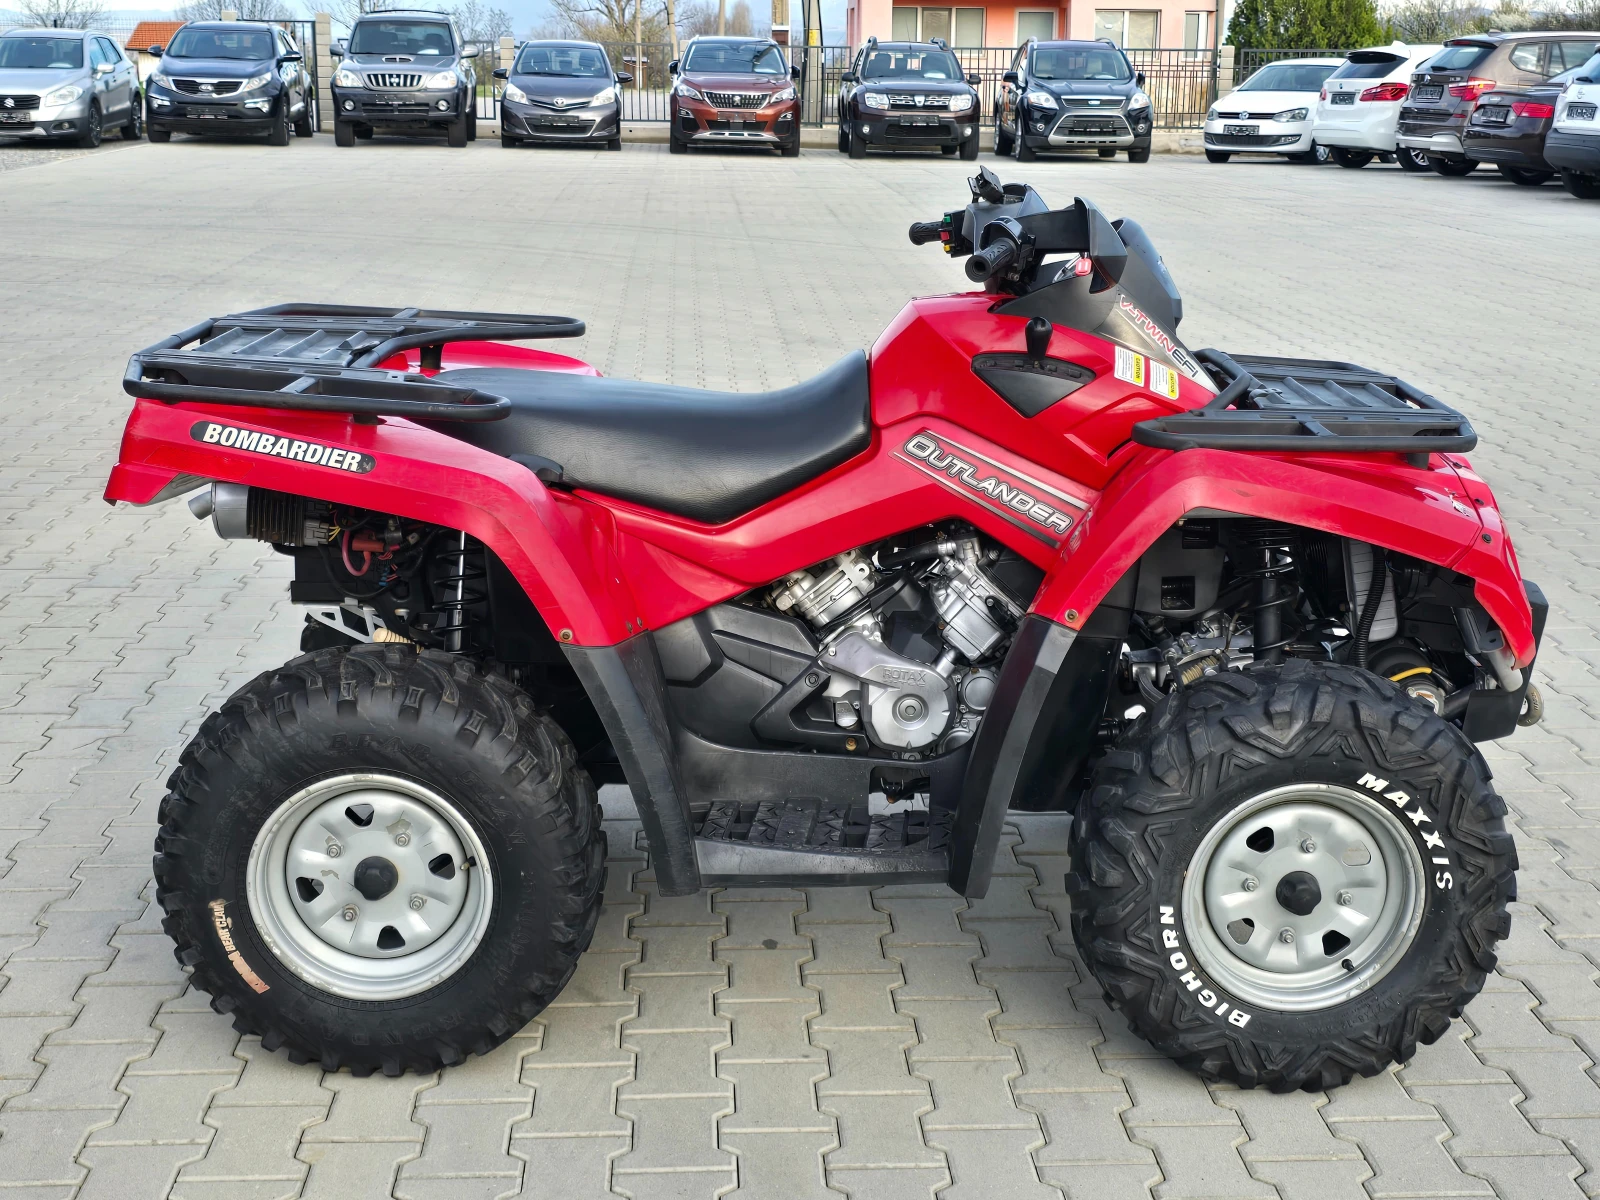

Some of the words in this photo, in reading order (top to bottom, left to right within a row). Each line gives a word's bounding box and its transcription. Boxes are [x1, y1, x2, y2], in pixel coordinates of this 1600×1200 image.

[202, 422, 362, 472] BOMBARDIER
[905, 431, 1073, 536] OUTLANDER
[882, 667, 928, 683] ROTAX
[1356, 771, 1455, 892] MAXXIS
[216, 929, 237, 953] BEAR
[1158, 905, 1252, 1029] BIGHORN
